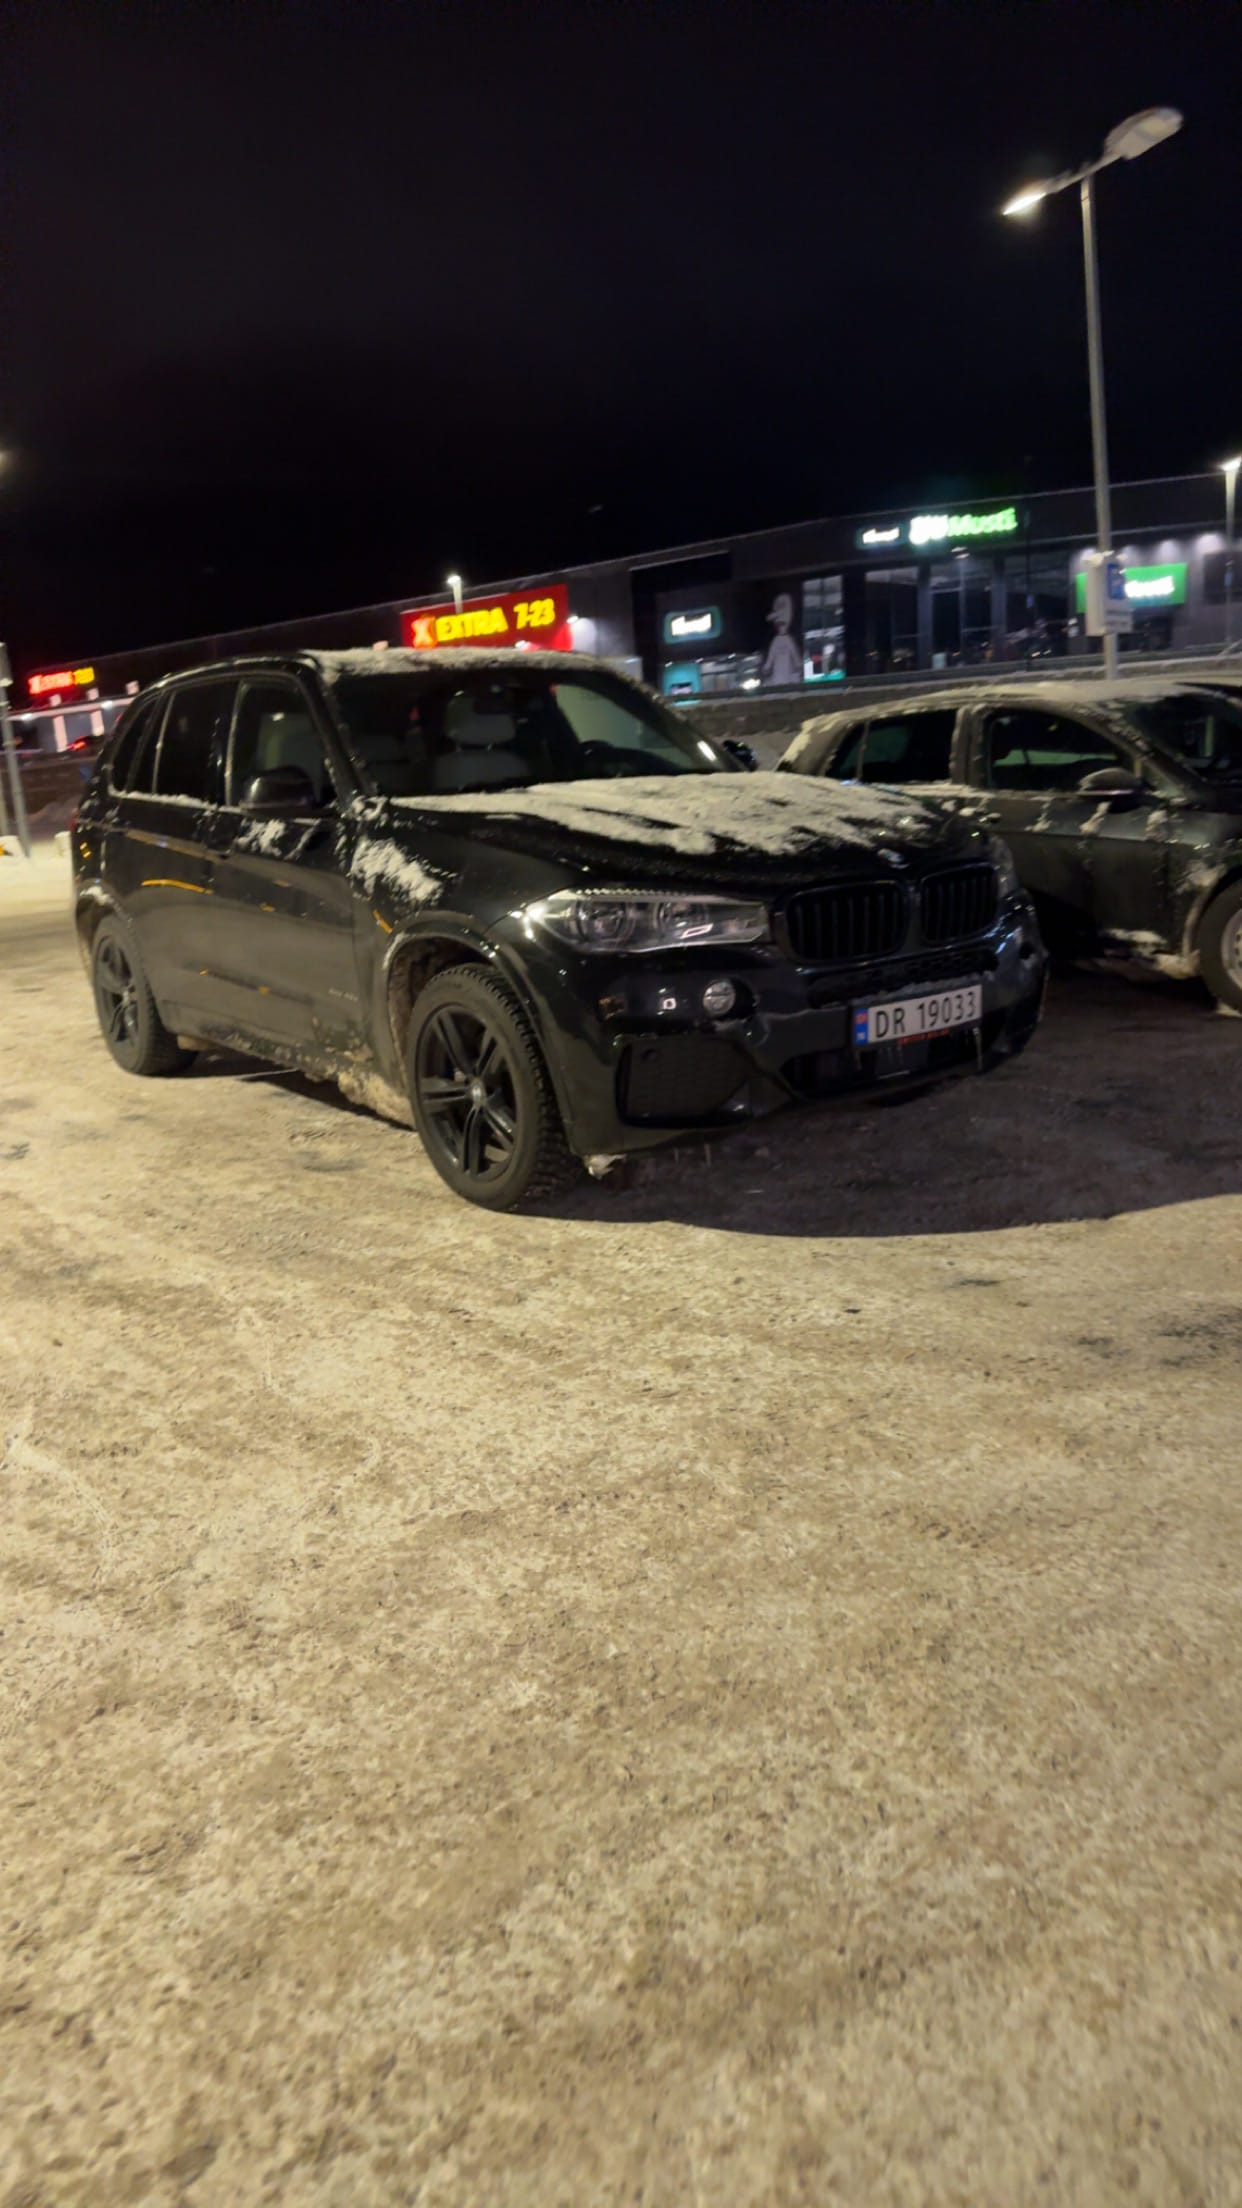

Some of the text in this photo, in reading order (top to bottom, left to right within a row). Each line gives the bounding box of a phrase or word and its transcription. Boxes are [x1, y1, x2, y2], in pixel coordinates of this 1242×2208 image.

[435, 607, 508, 642] EXTRA
[875, 991, 975, 1038] DR 19033
